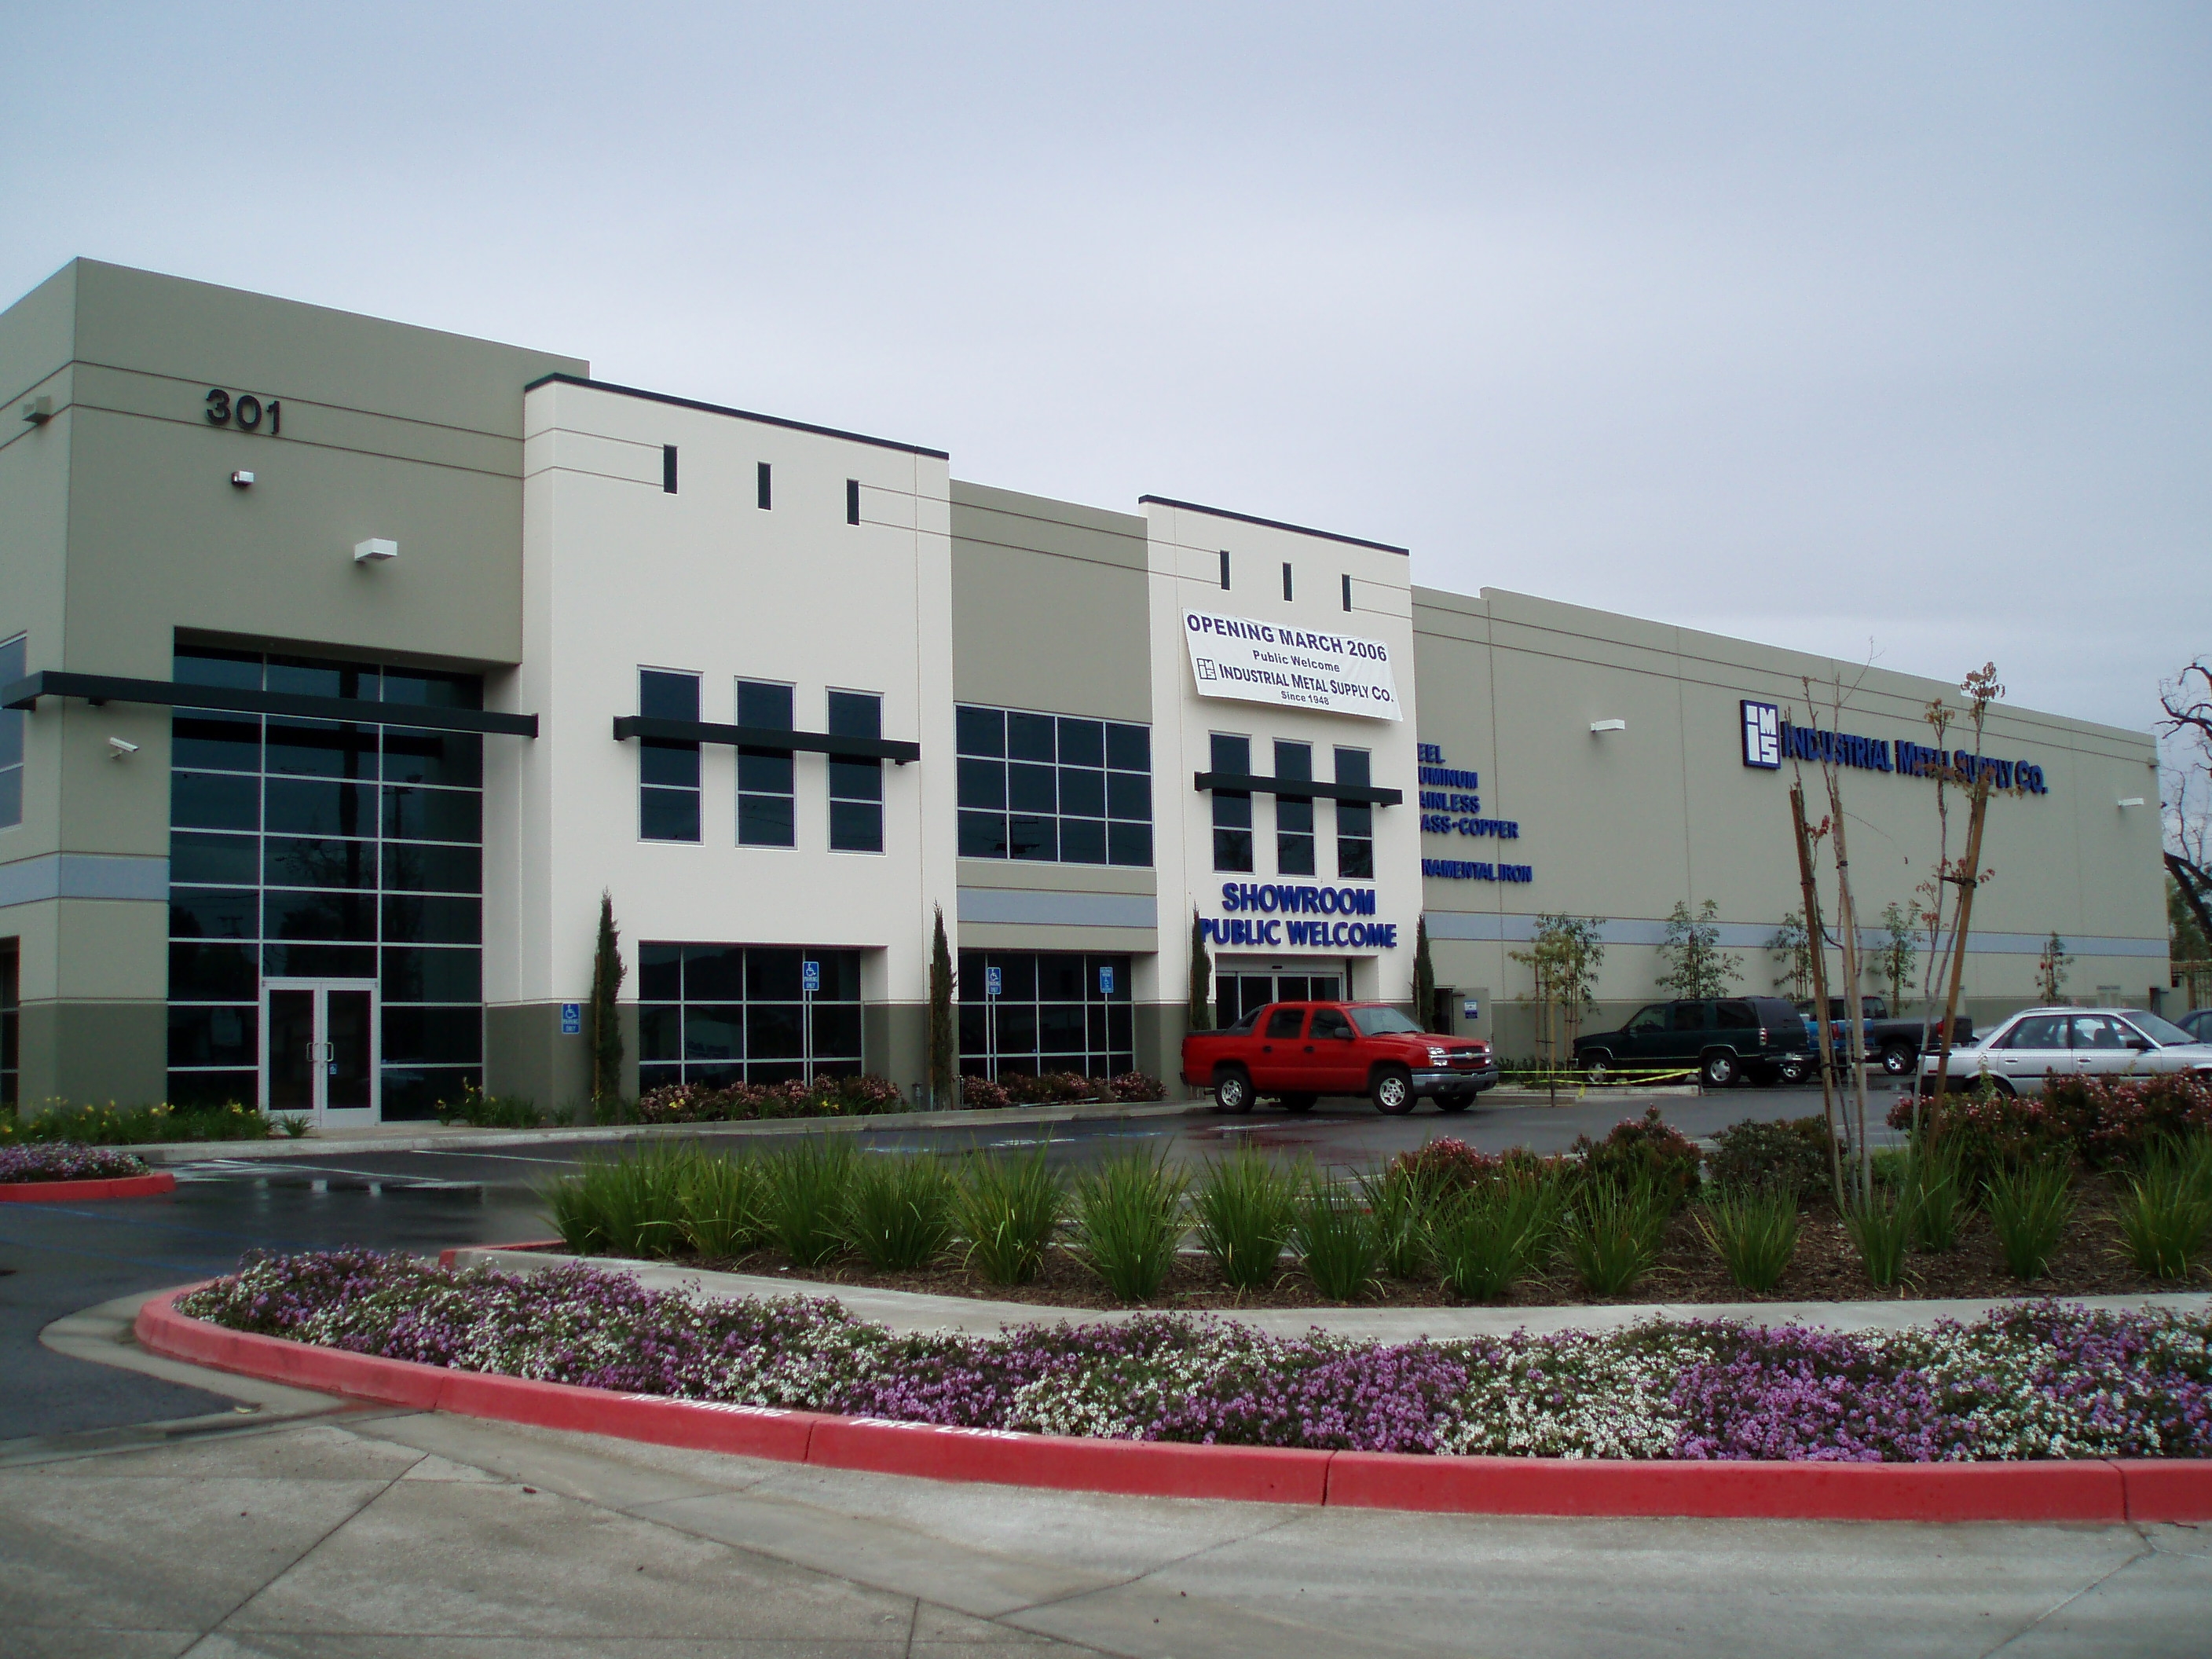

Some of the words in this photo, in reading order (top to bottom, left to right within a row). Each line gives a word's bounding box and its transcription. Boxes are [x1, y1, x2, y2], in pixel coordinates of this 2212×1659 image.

[206, 389, 280, 434] 301
[1187, 614, 1275, 643] OPENING
[1280, 628, 1343, 654] MARCH
[1347, 640, 1387, 661] 2006
[1253, 650, 1289, 665] Public
[1291, 655, 1340, 672] Welcome
[1219, 663, 1289, 687] INDUSTRIAL
[1291, 674, 1328, 693] METAL
[1330, 679, 1368, 698] SUPPLY
[1372, 686, 1394, 702] CO.
[1281, 690, 1306, 702] Since
[1308, 694, 1329, 705] 1948
[1780, 721, 1895, 771] INDUSTRIAL
[2015, 760, 2049, 795] CO.
[1498, 863, 1533, 882] IRON
[1221, 882, 1375, 915] SHOWROOM
[1199, 917, 1281, 945] PUBLIC
[1286, 921, 1397, 947] WELCOME
[935, 1426, 1029, 1440] LANE
